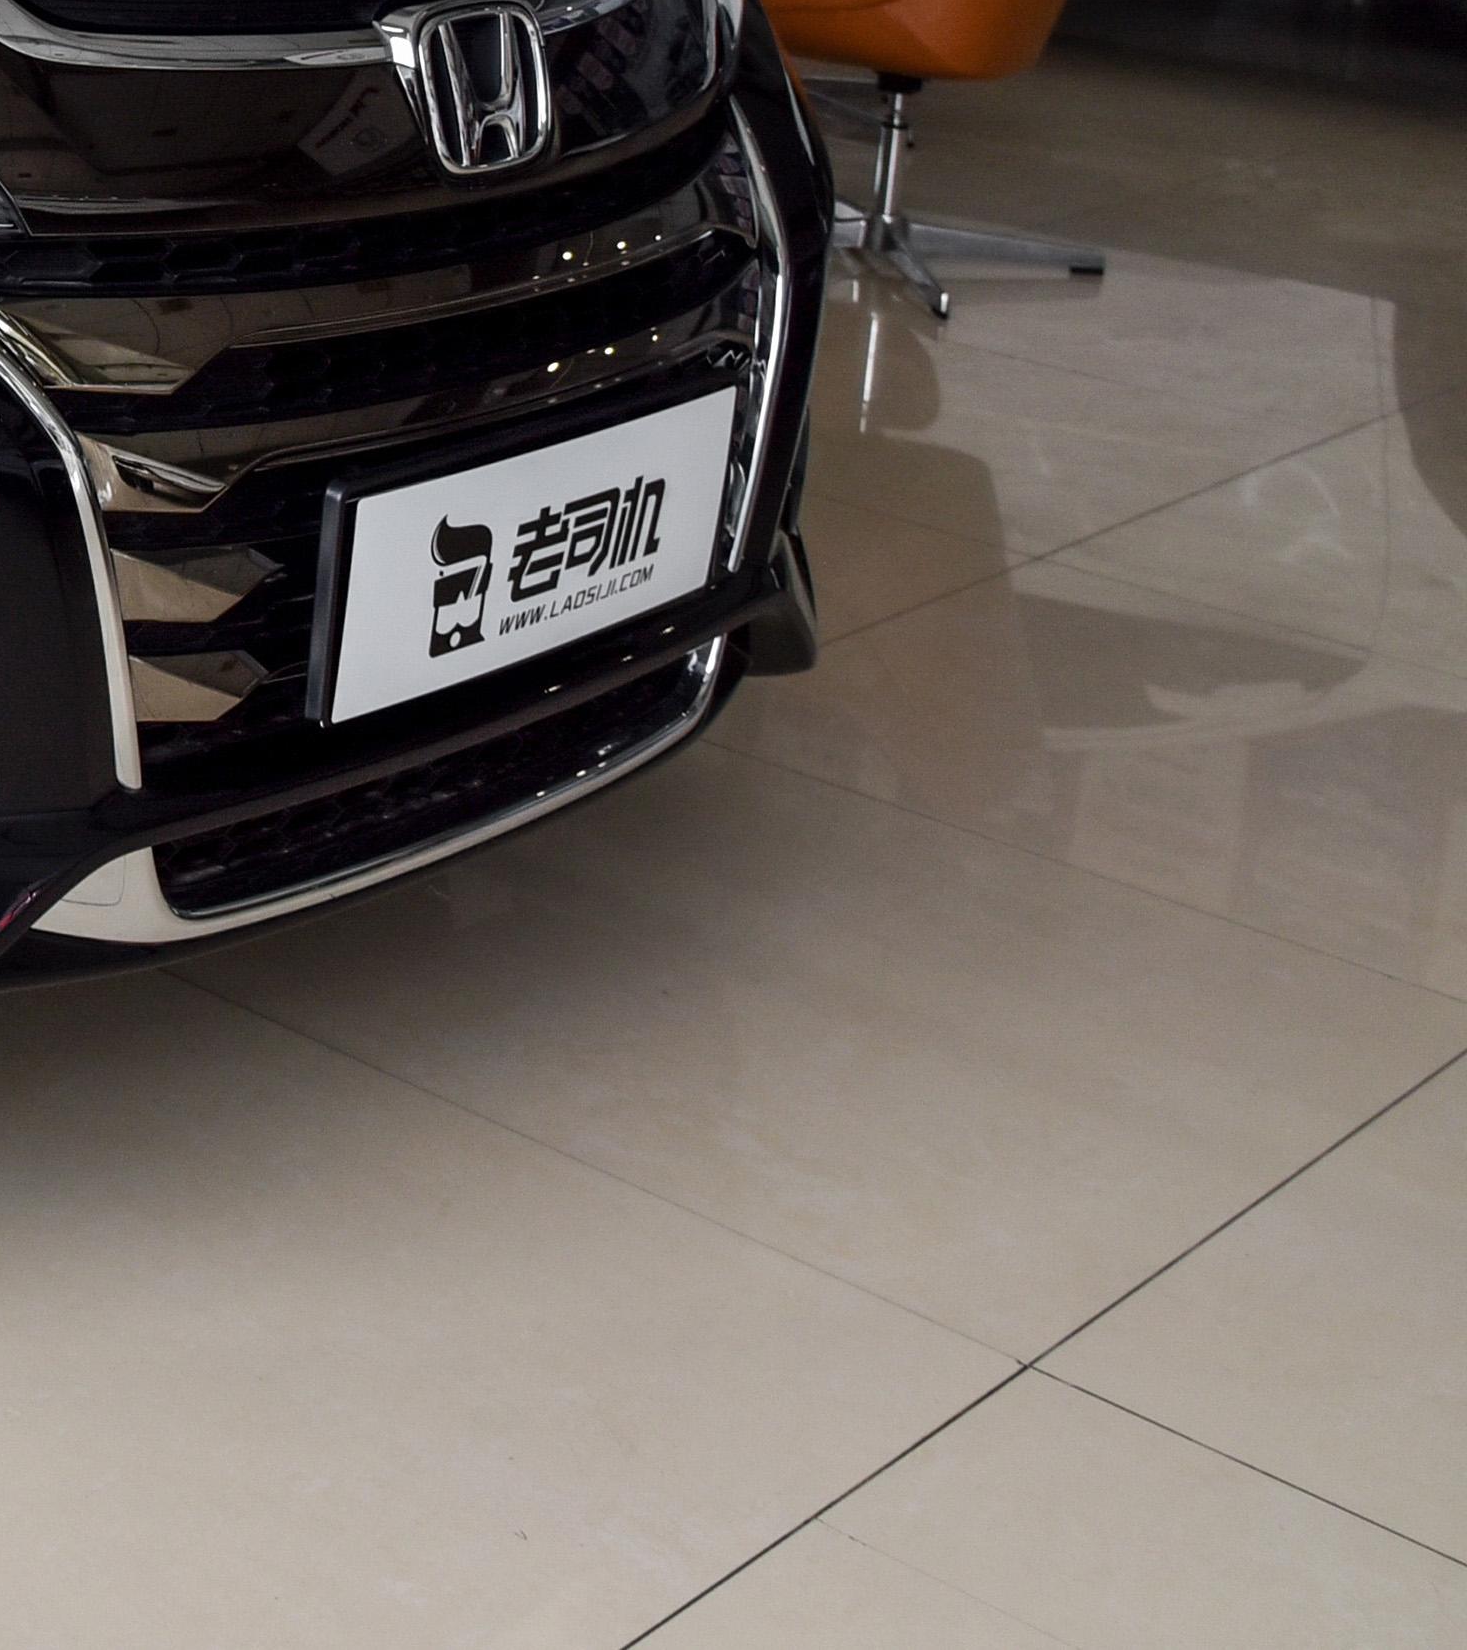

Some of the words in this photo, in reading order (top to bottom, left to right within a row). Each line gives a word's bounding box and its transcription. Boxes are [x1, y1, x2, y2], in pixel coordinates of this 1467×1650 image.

[507, 475, 666, 603] 老司机
[499, 563, 655, 636] WWW.LAOSIJI.COM
